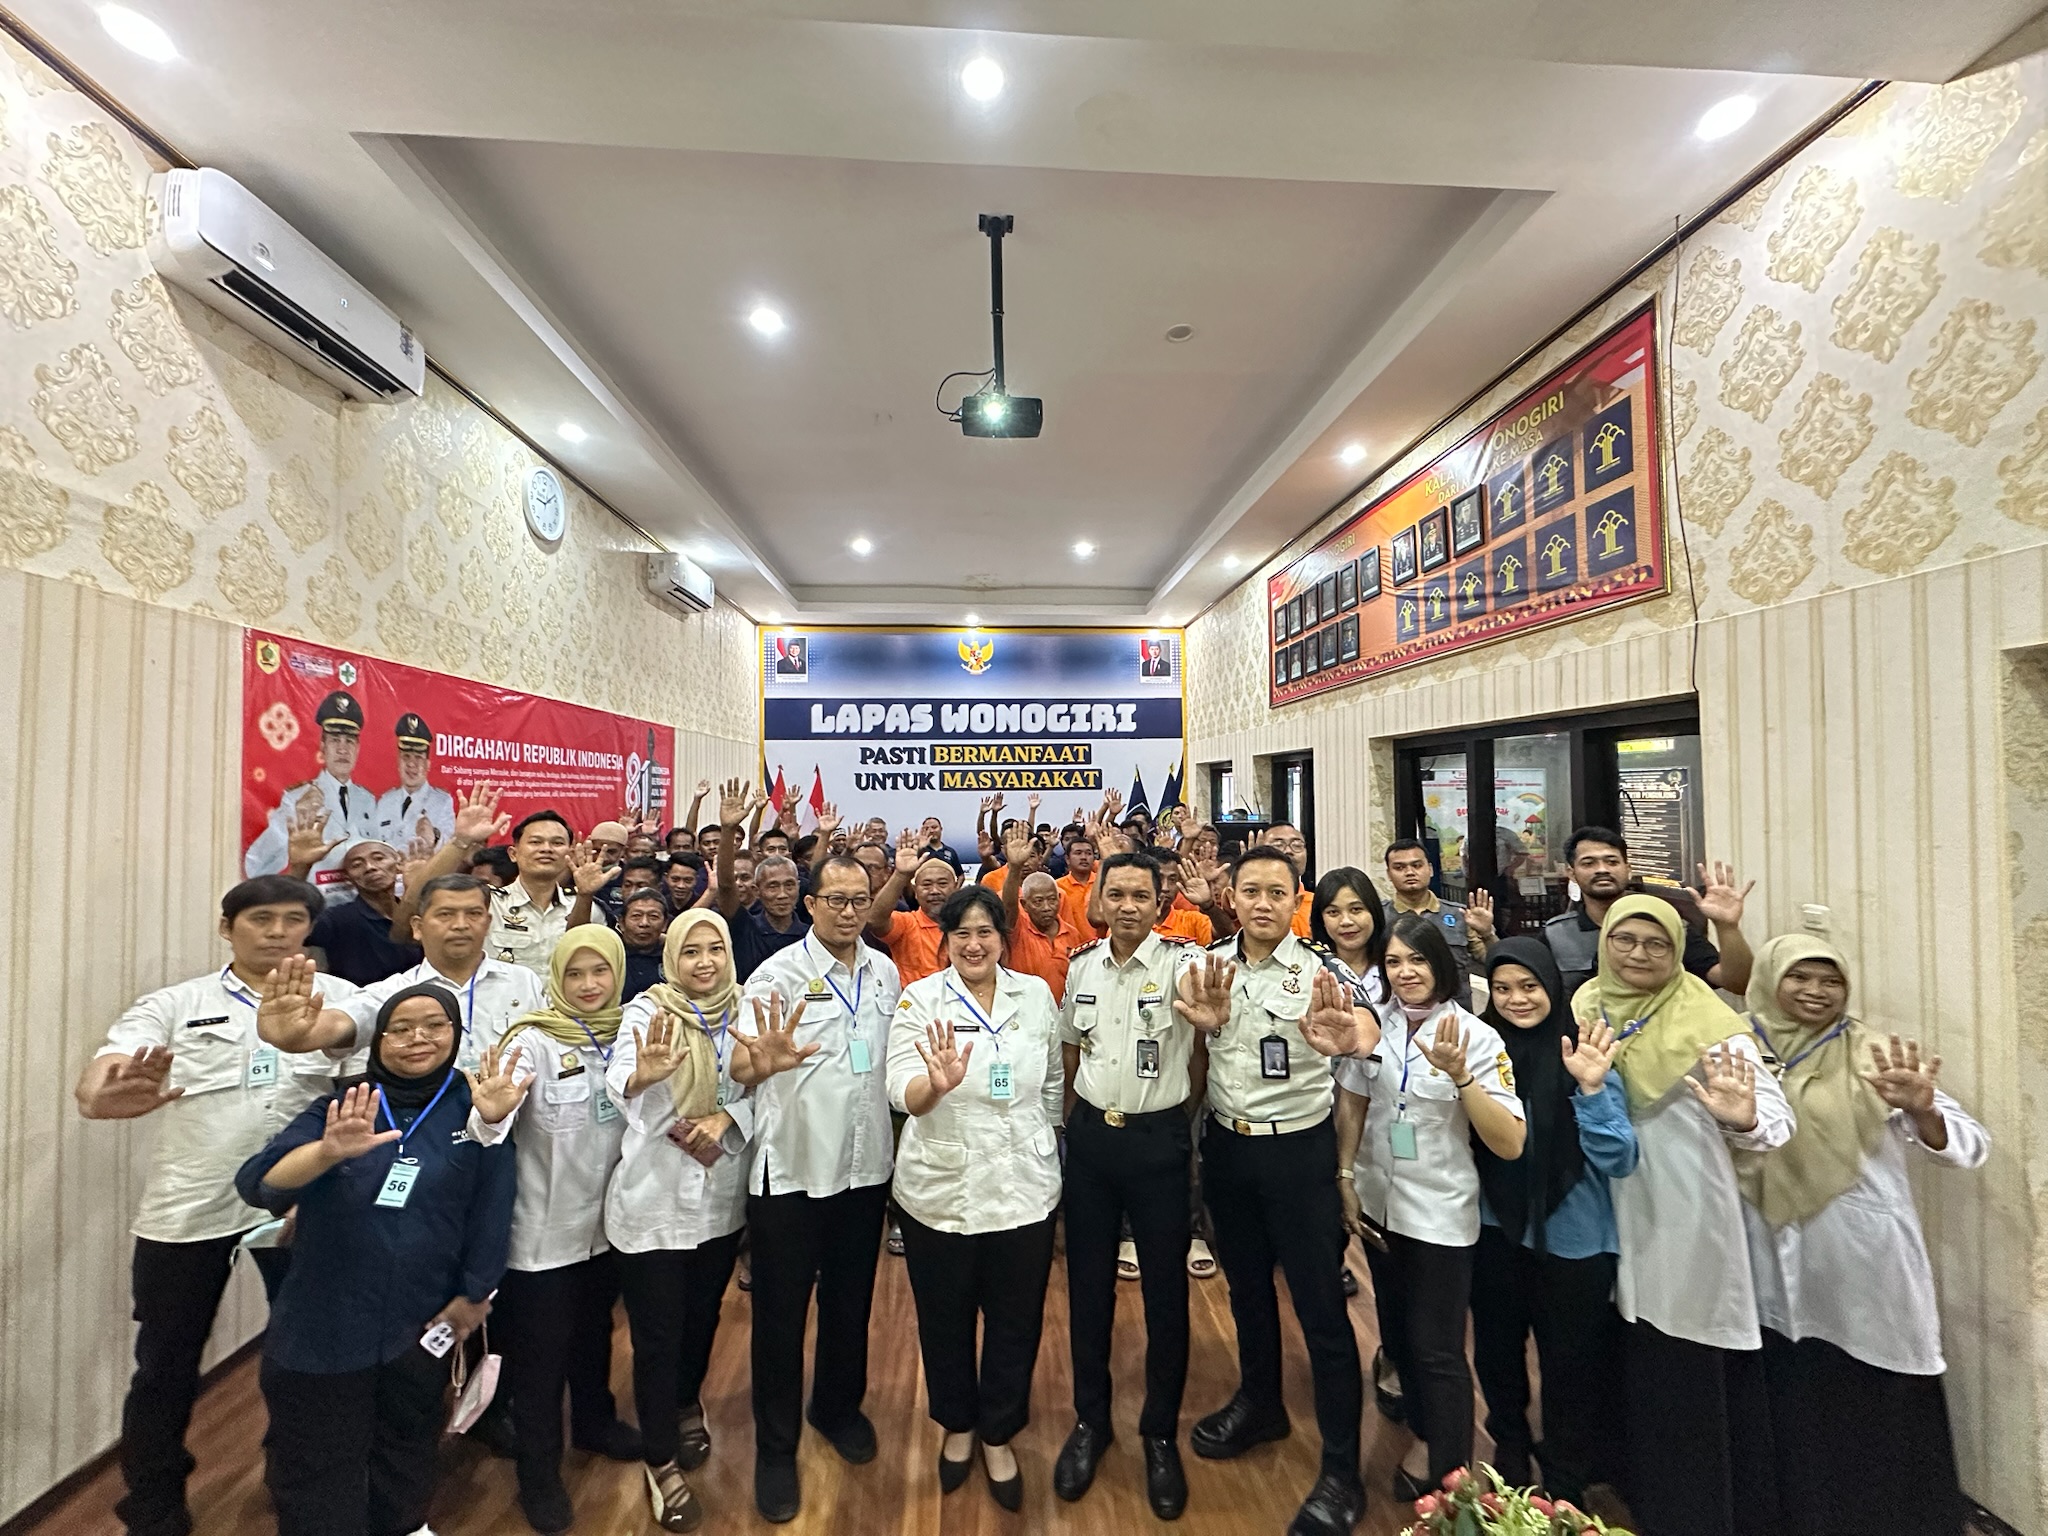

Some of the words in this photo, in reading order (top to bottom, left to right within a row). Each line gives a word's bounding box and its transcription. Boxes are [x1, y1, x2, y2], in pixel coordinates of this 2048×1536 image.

[1492, 391, 1564, 451] ONOGIRI
[1493, 451, 1507, 470] KE
[1509, 430, 1544, 459] MASA
[811, 703, 933, 733] LAPAS
[940, 703, 1137, 733] WONOGIRI
[435, 733, 520, 762] DIRGAHAYU
[523, 743, 578, 766] REPUBLIK
[578, 749, 624, 770] INDONESIA
[859, 747, 926, 765] PASTI
[934, 746, 1089, 763] BERMANFAAT
[854, 772, 935, 790] UNTUK
[943, 770, 1100, 789] MASYARAKAT
[252, 1064, 270, 1075] 61
[994, 1078, 1009, 1087] 65
[387, 1180, 408, 1192] 56
